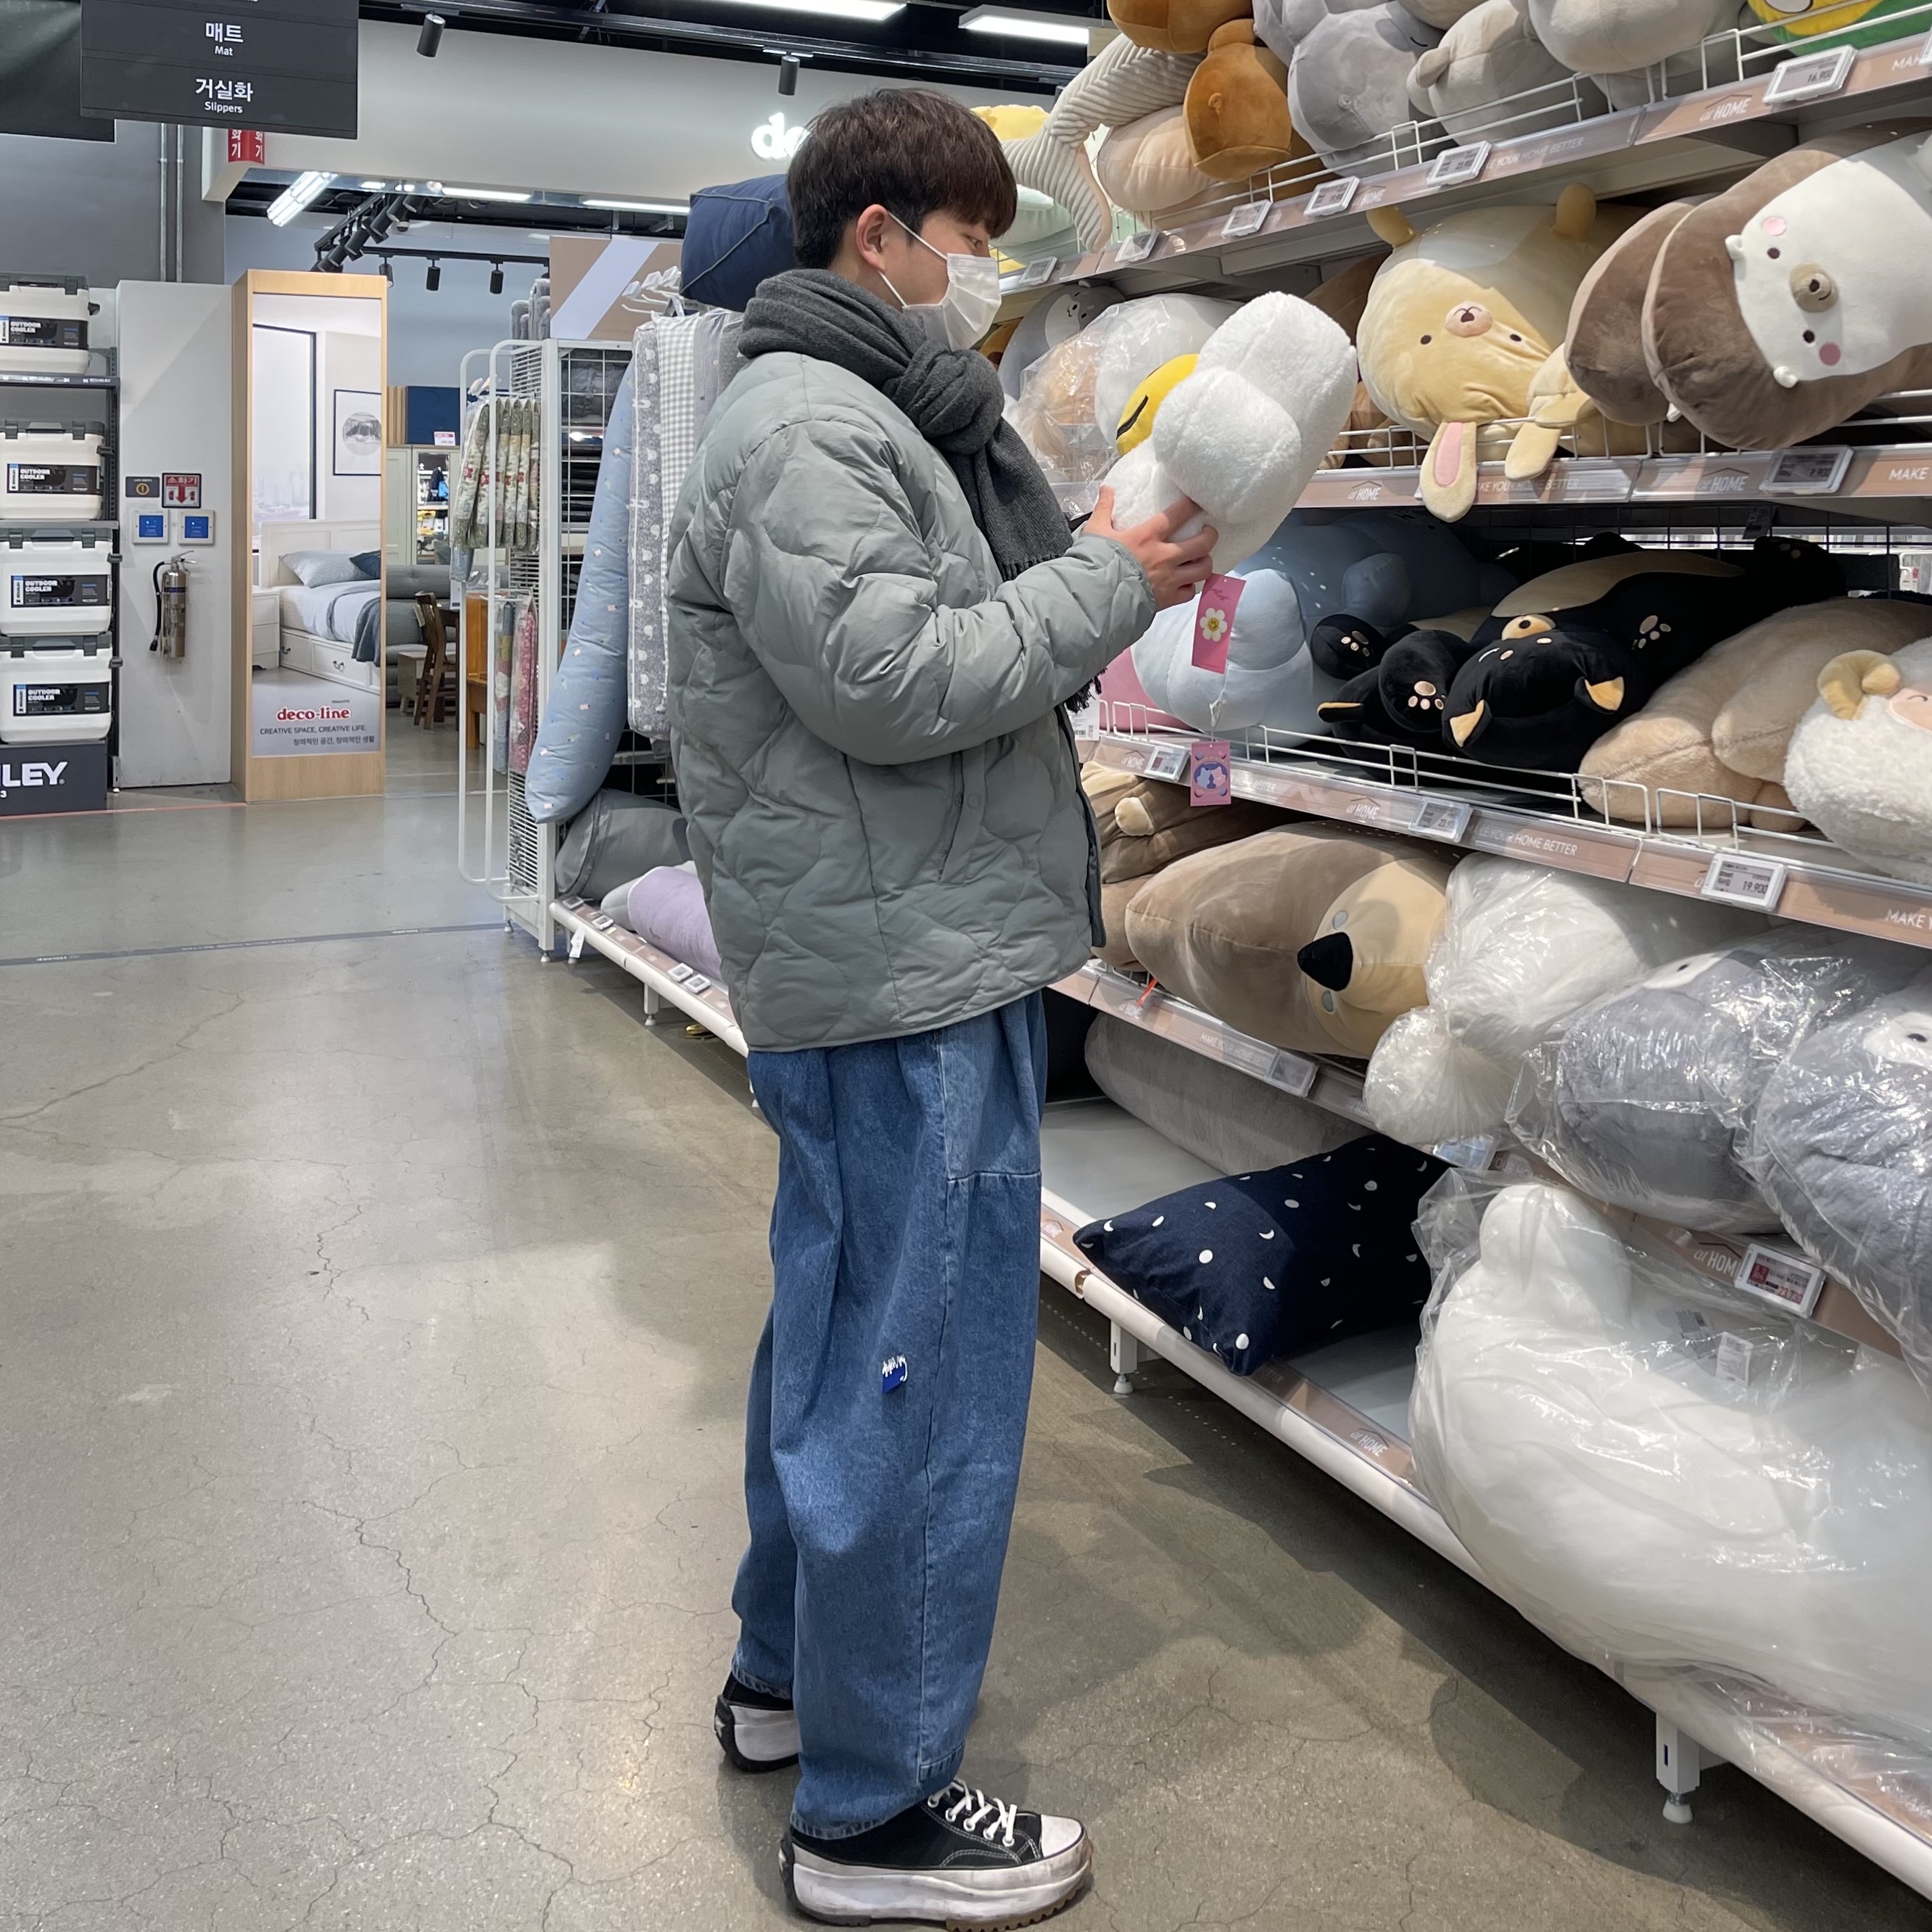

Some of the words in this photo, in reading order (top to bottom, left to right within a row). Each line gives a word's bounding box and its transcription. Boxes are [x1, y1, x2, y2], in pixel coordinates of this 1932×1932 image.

[205, 22, 244, 42] 매트
[215, 46, 234, 56] Mat
[195, 78, 253, 102] 거실화
[205, 102, 243, 114] Slippers
[1712, 97, 1752, 120] HOME
[167, 476, 197, 485] 소화기
[1888, 467, 1930, 480] MAKE
[1545, 479, 1579, 490] BETTER
[1710, 476, 1749, 492] HOME
[1355, 487, 1382, 500] HOME
[276, 706, 350, 721] deco-line
[0, 761, 68, 787] LEY
[1354, 804, 1380, 820] HOME
[1514, 833, 1543, 848] HOME
[1543, 839, 1577, 856] BETTER
[1886, 908, 1926, 928] MAKE
[1200, 1033, 1218, 1046] MAKE
[1494, 1157, 1515, 1173] OUR
[1358, 1435, 1388, 1457] HOME
